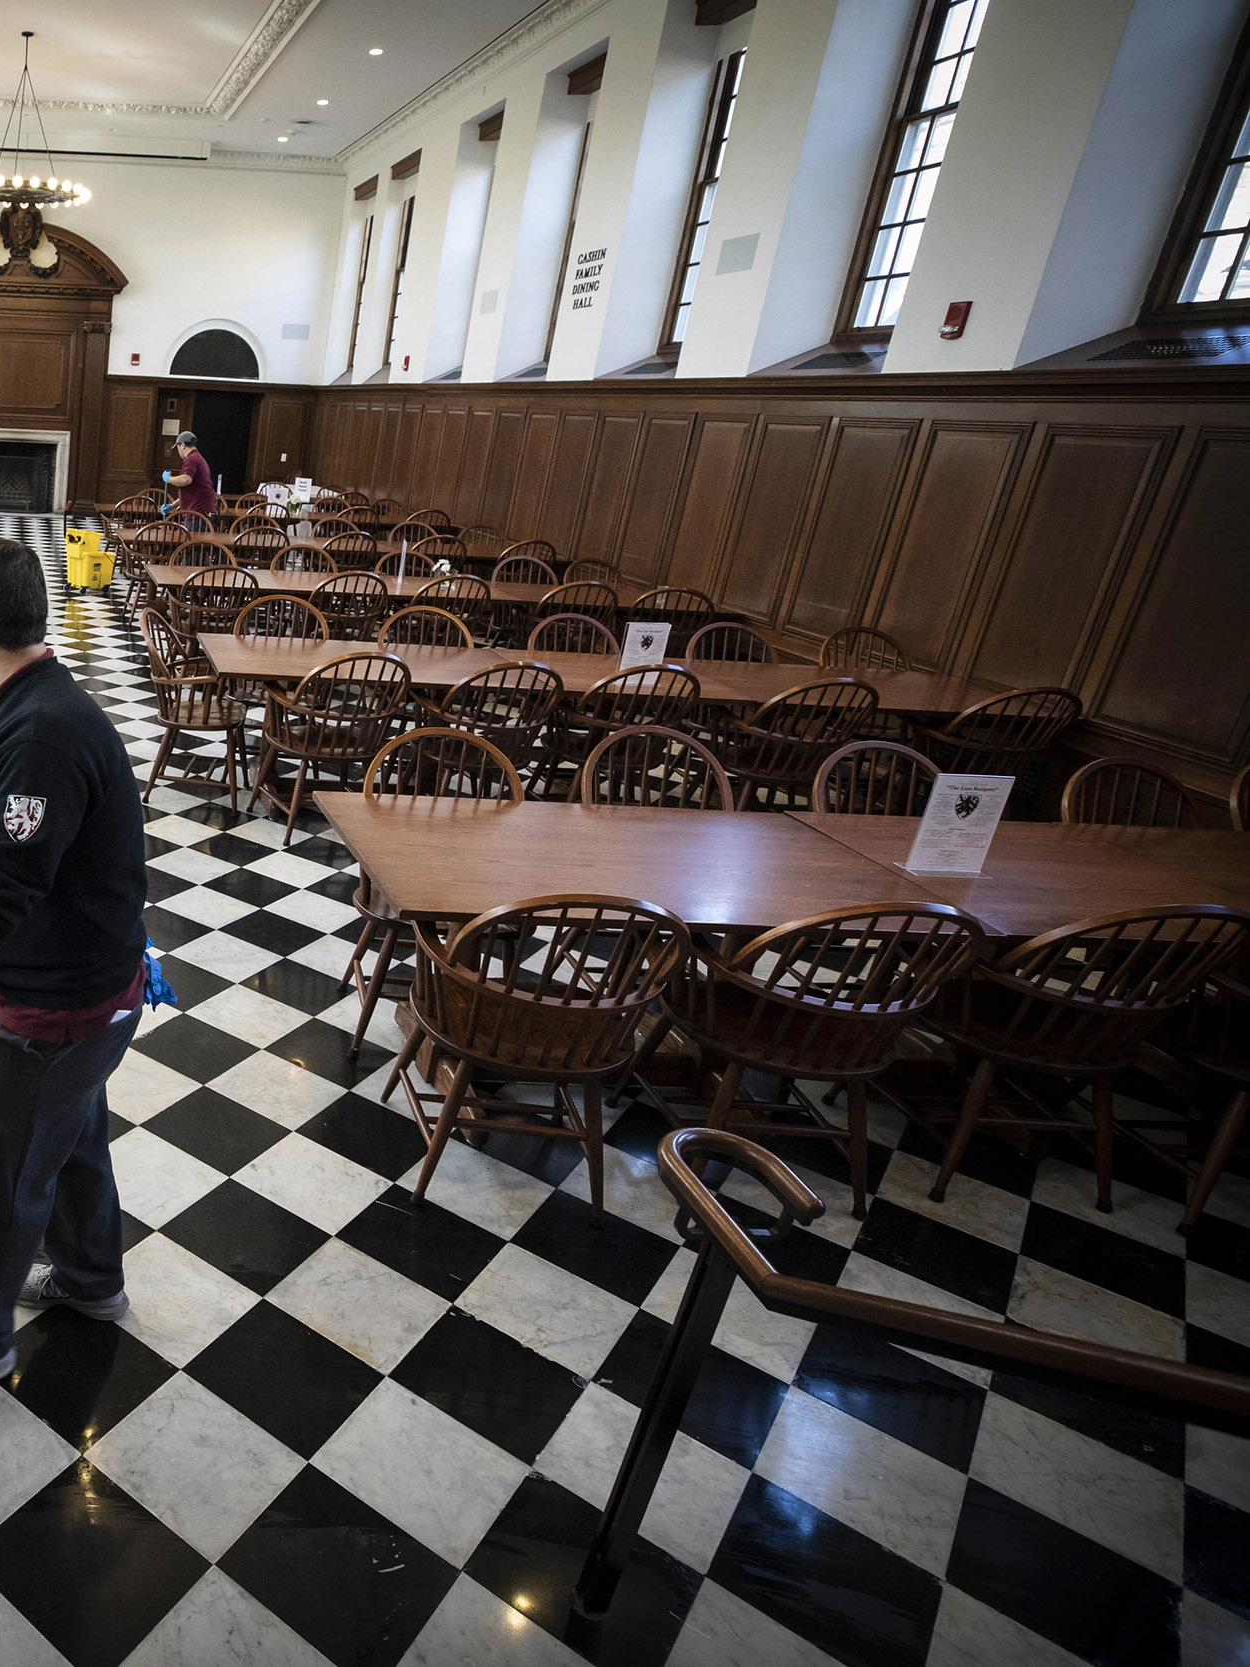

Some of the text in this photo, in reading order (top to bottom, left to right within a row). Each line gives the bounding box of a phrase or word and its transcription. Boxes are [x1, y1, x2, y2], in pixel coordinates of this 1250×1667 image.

[578, 248, 607, 265] CASHIN
[575, 264, 604, 280] FAMILY
[572, 280, 600, 295] DINING
[572, 297, 593, 310] HALL
